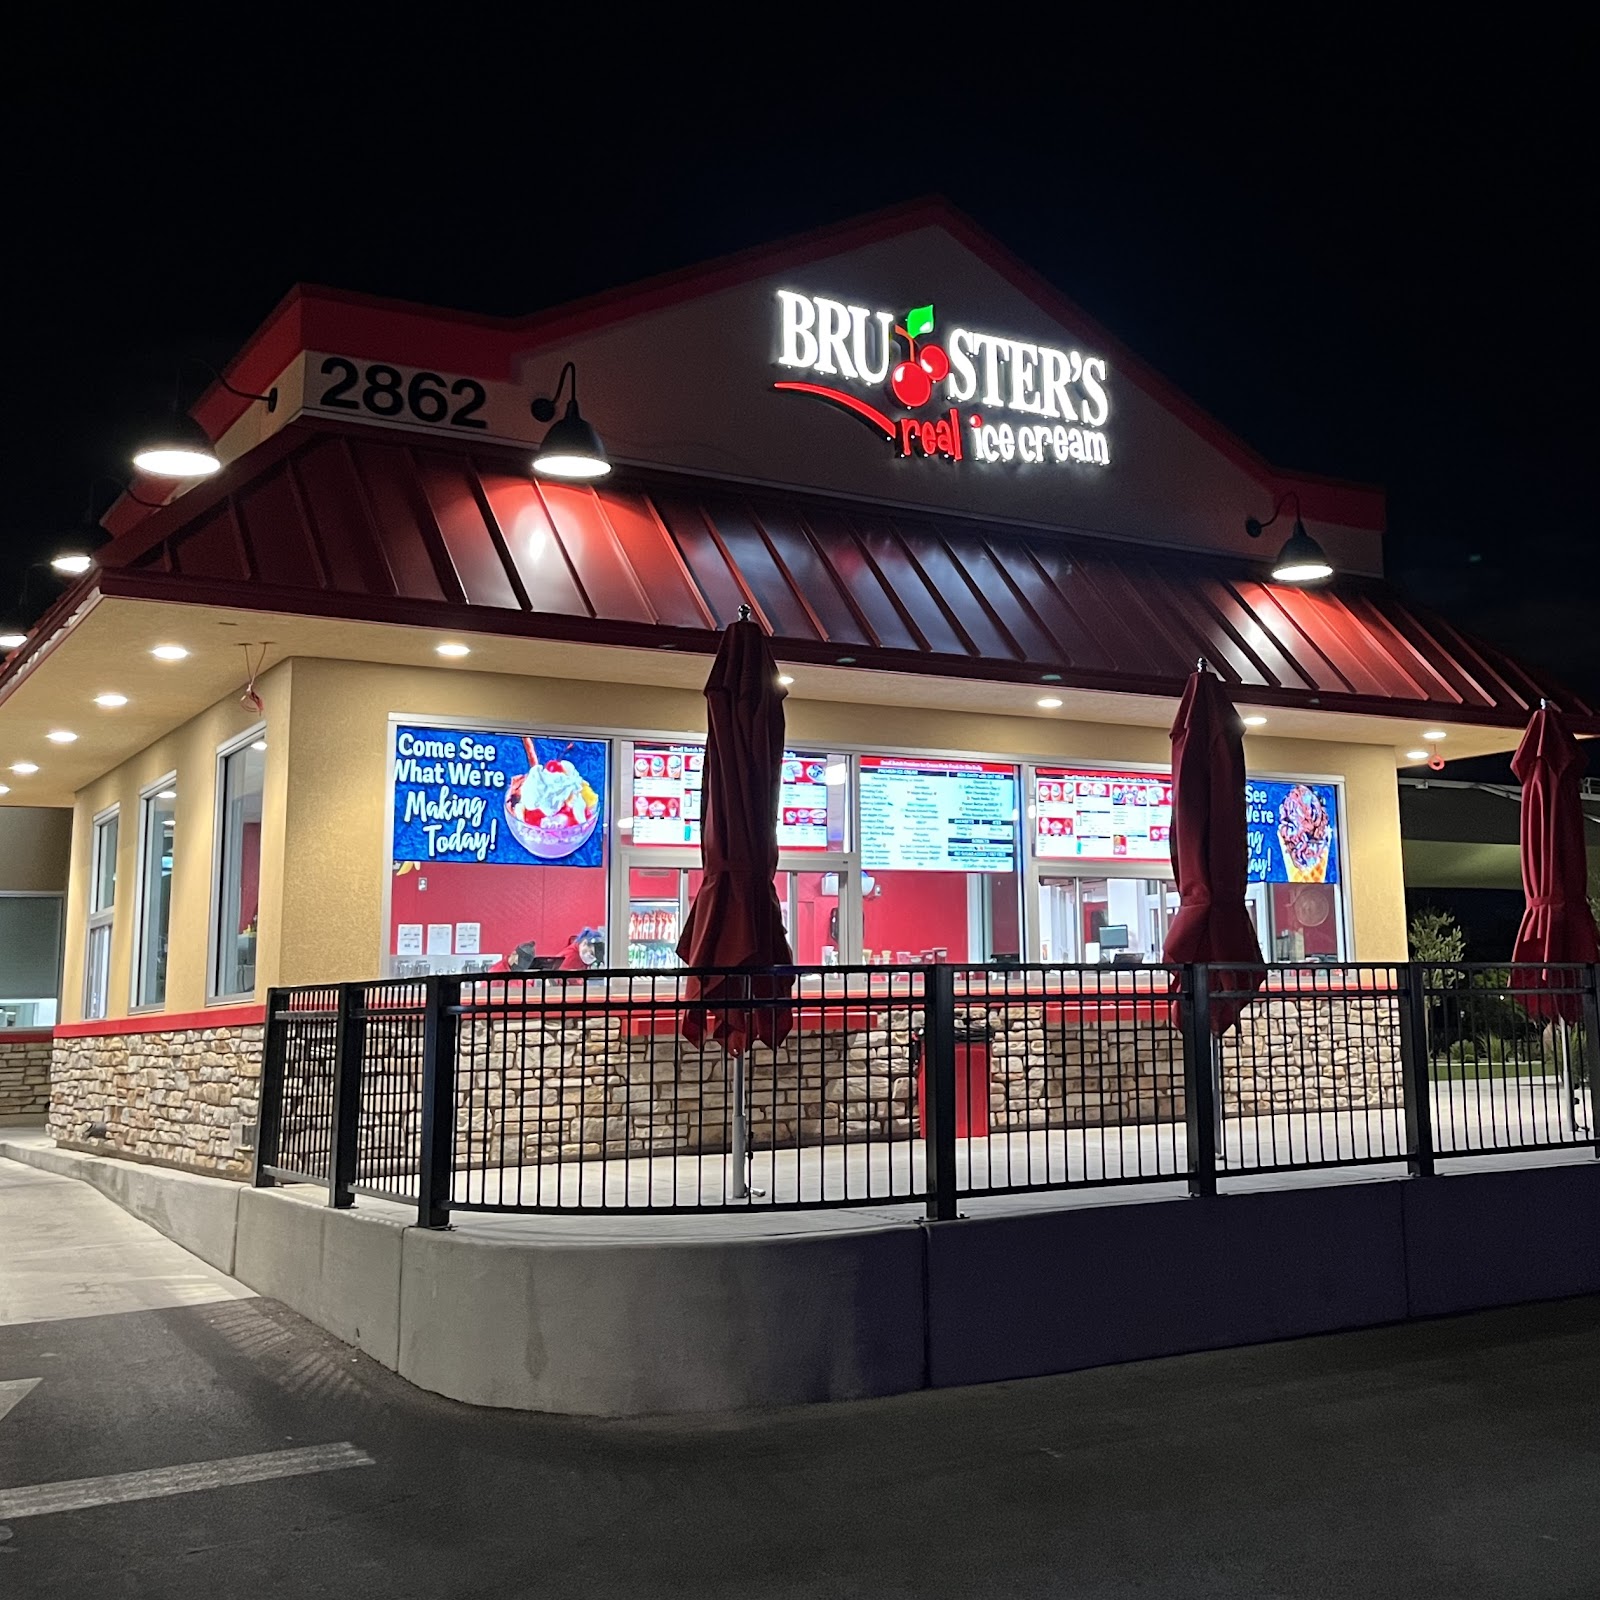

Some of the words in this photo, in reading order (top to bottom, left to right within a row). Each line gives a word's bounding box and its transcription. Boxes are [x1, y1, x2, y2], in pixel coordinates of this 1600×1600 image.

[320, 356, 488, 429] 2862
[899, 408, 963, 461] real
[969, 413, 1015, 463] ice
[1018, 424, 1111, 466] cream
[398, 732, 455, 758] Come
[458, 737, 496, 761] See
[448, 762, 505, 787] We're
[1245, 784, 1268, 804] See
[404, 785, 487, 827] Making
[422, 818, 498, 861] Today!
